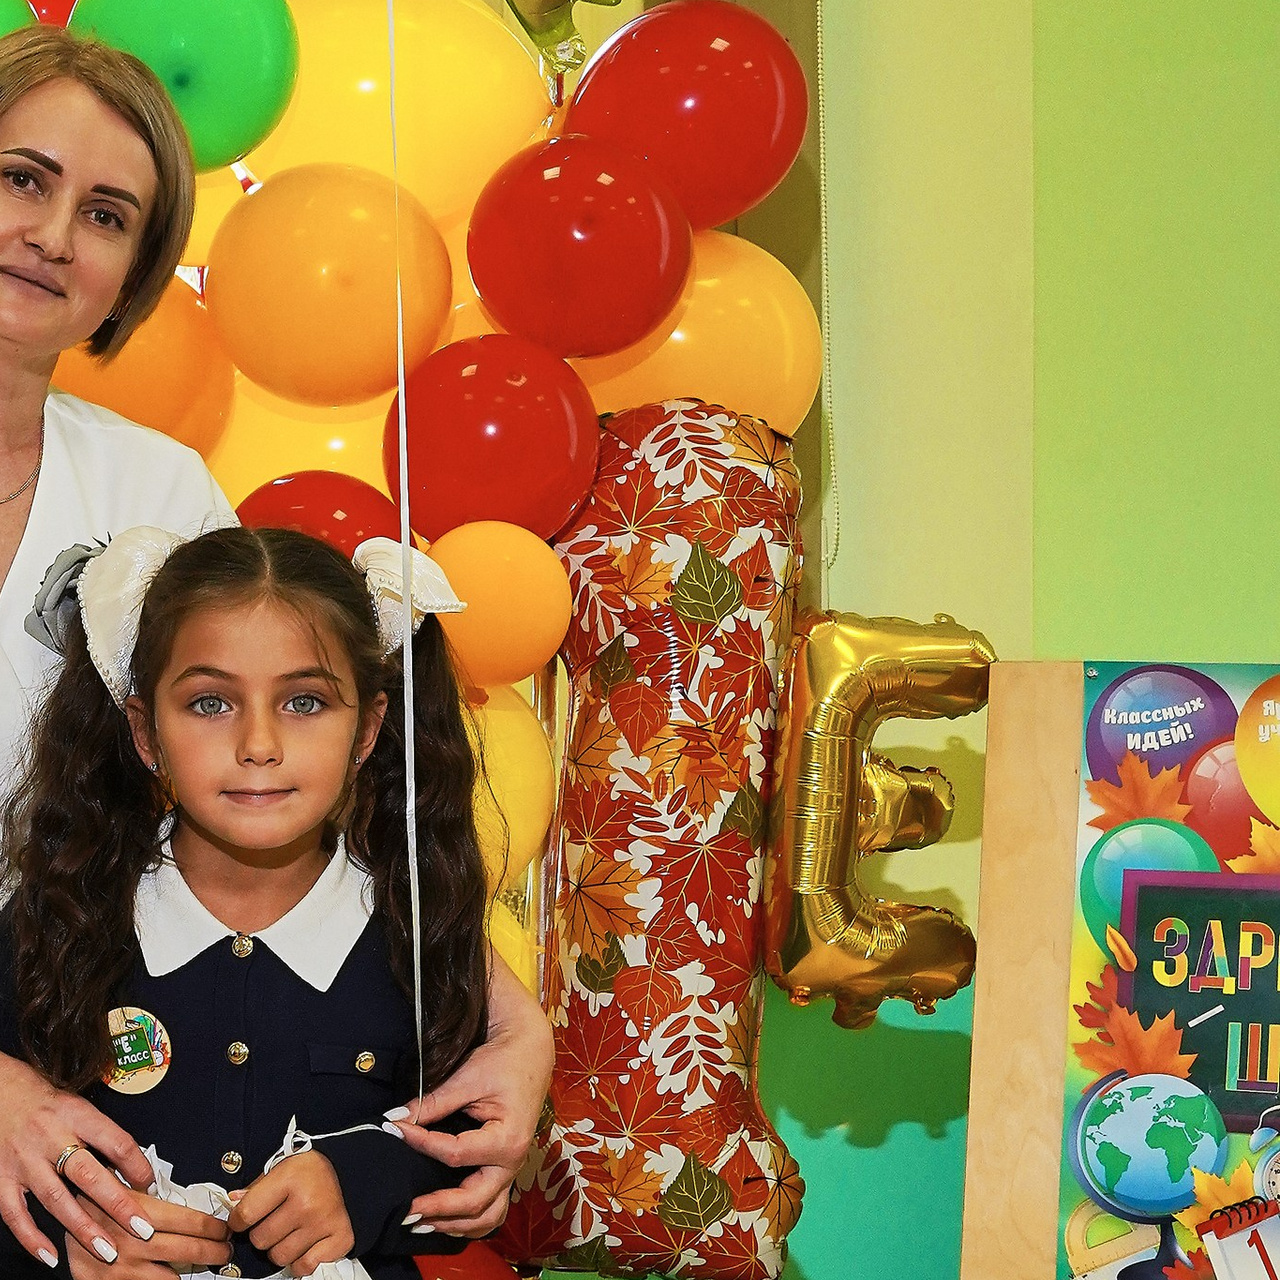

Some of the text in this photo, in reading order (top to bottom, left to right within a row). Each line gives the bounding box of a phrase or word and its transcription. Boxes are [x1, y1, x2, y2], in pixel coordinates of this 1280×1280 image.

[1104, 697, 1205, 725] Классных
[1126, 720, 1195, 753] ИДЕЙ!
[1152, 917, 1280, 995] ЗДР
[117, 1050, 149, 1065] класс
